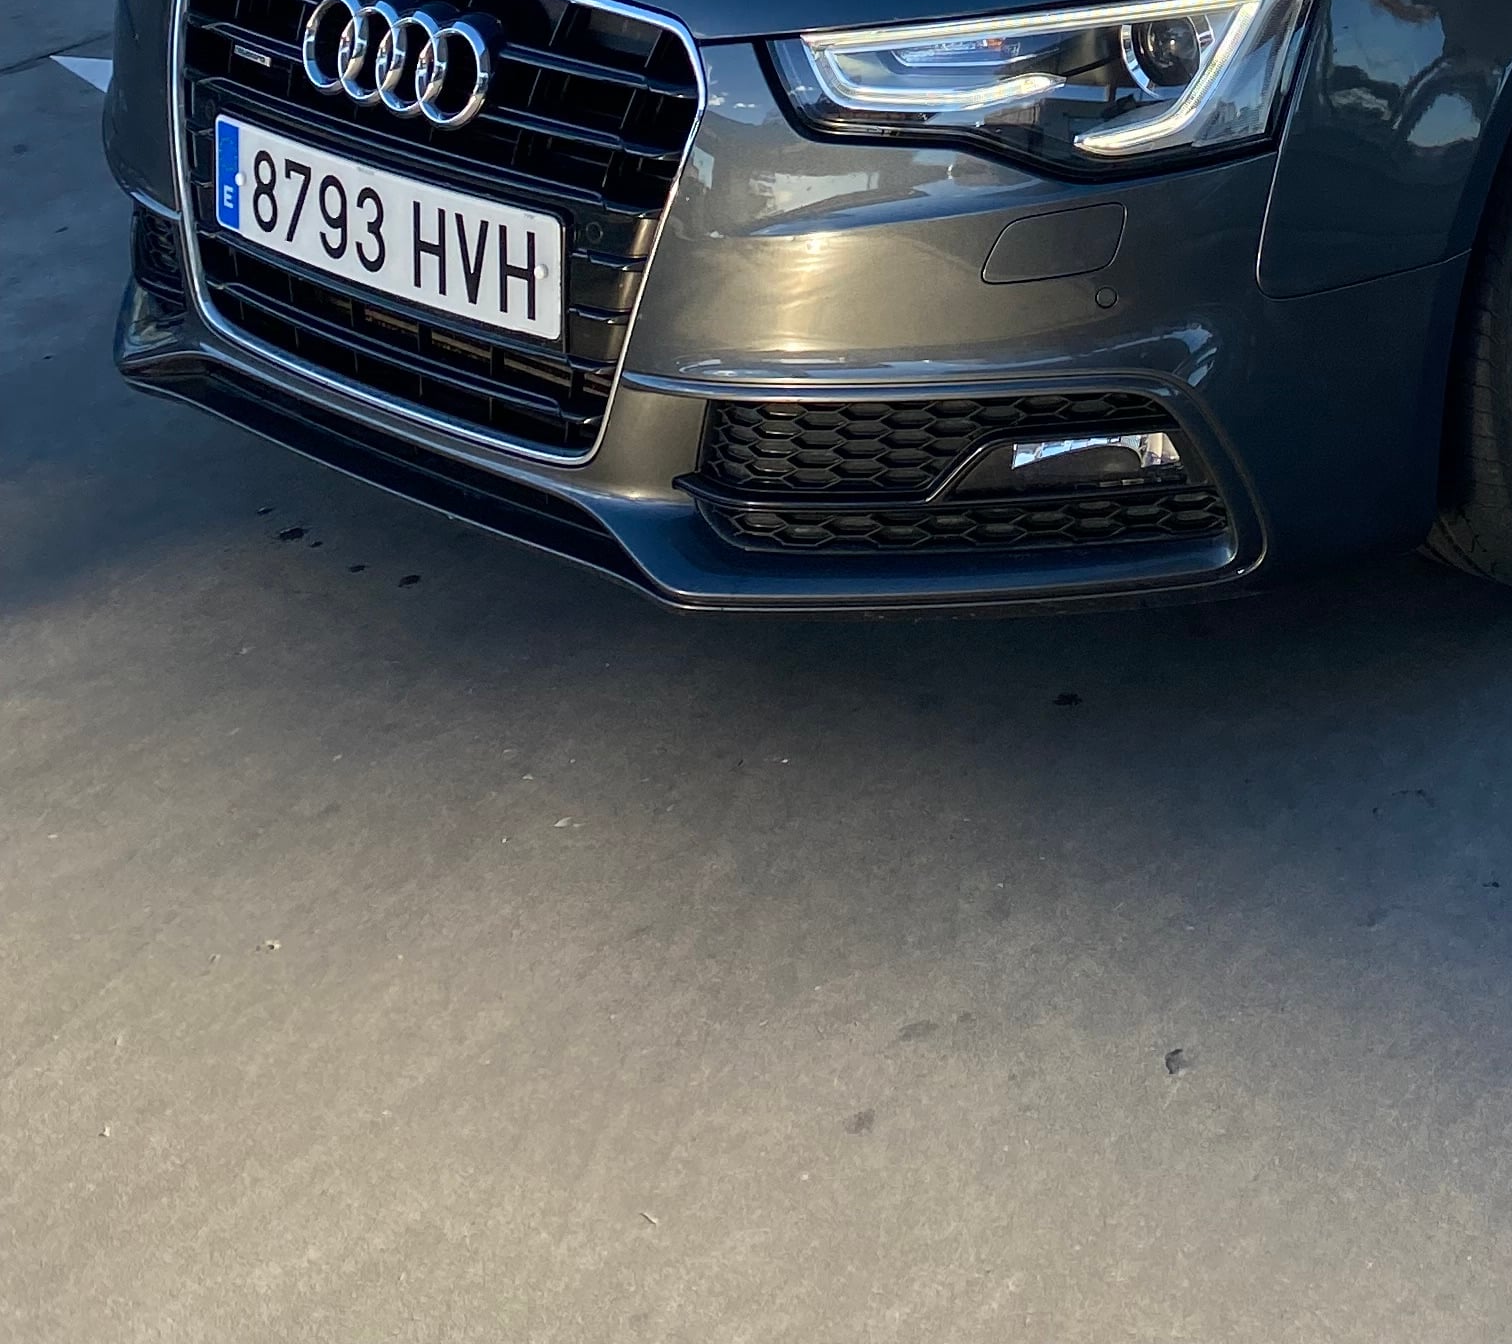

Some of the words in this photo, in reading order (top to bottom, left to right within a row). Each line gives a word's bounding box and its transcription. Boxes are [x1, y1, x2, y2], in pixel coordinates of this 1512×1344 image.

[223, 184, 234, 209] E
[252, 149, 387, 273] 8793
[412, 199, 537, 321] HVH
